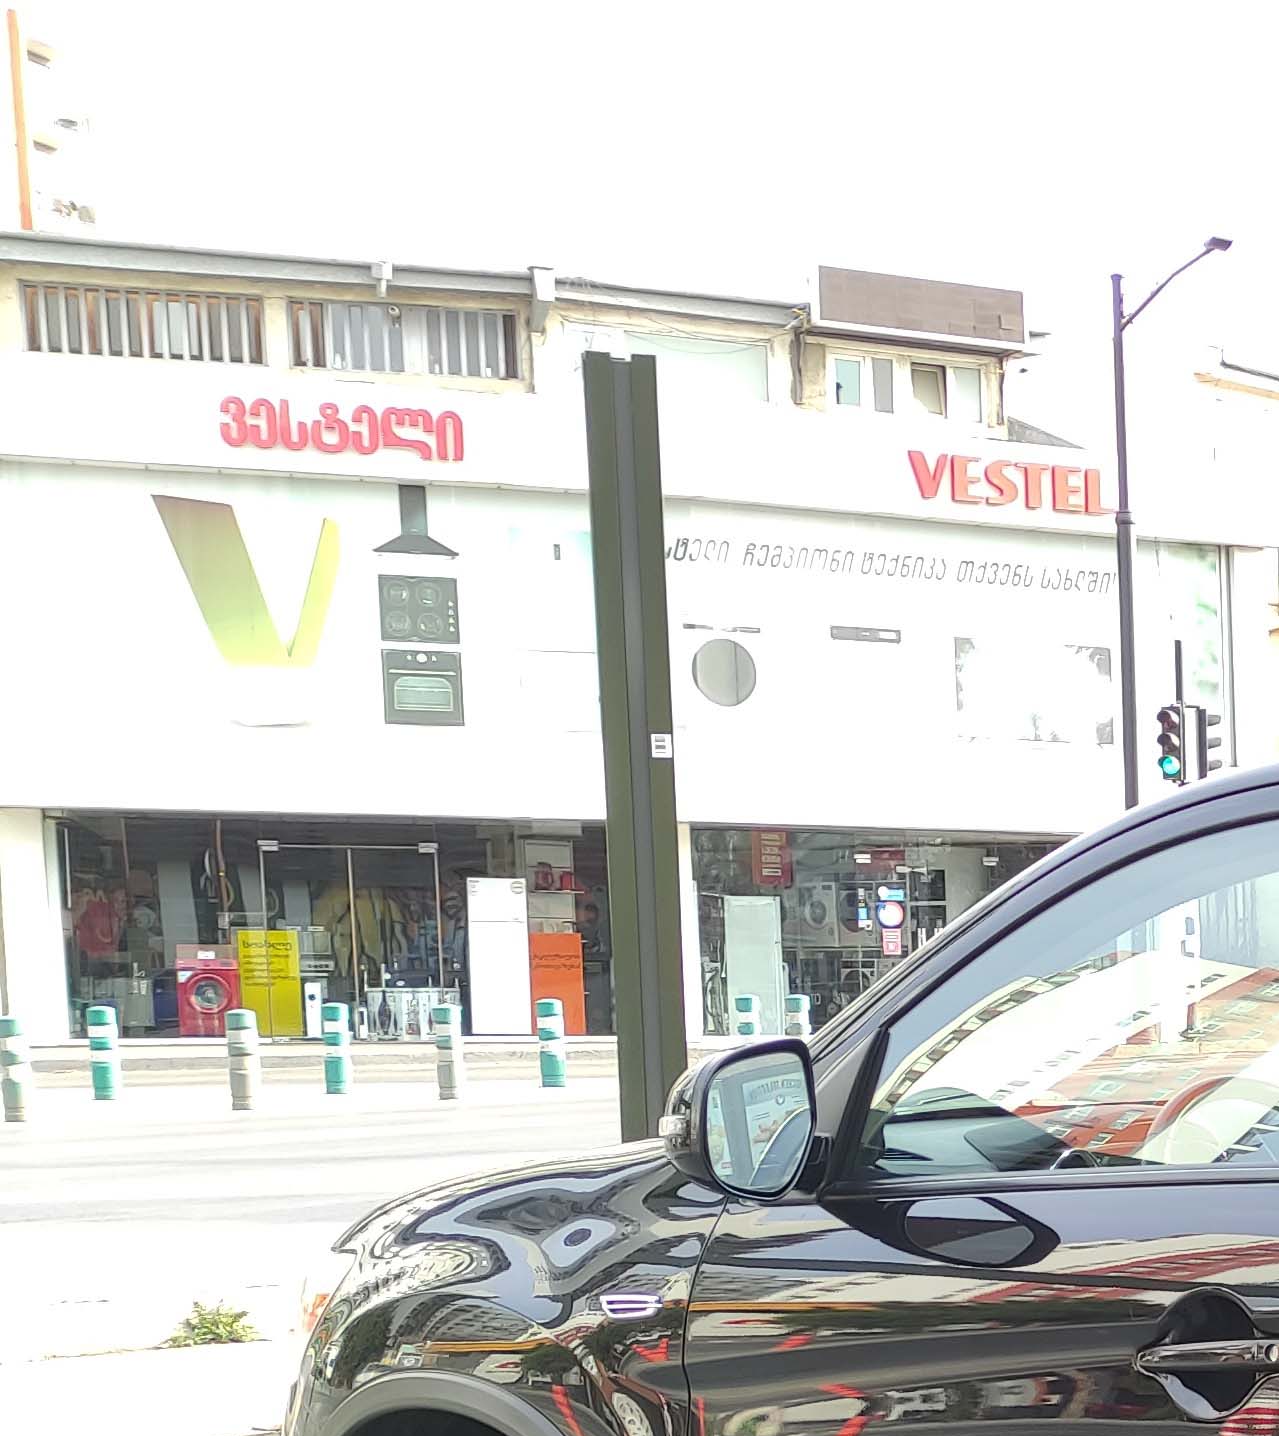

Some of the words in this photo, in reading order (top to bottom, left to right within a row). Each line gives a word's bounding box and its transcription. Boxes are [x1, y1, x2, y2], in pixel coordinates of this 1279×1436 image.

[219, 395, 464, 462] ვესტელი
[907, 449, 1118, 517] VESTEL
[860, 551, 947, 581] ტექნიკა
